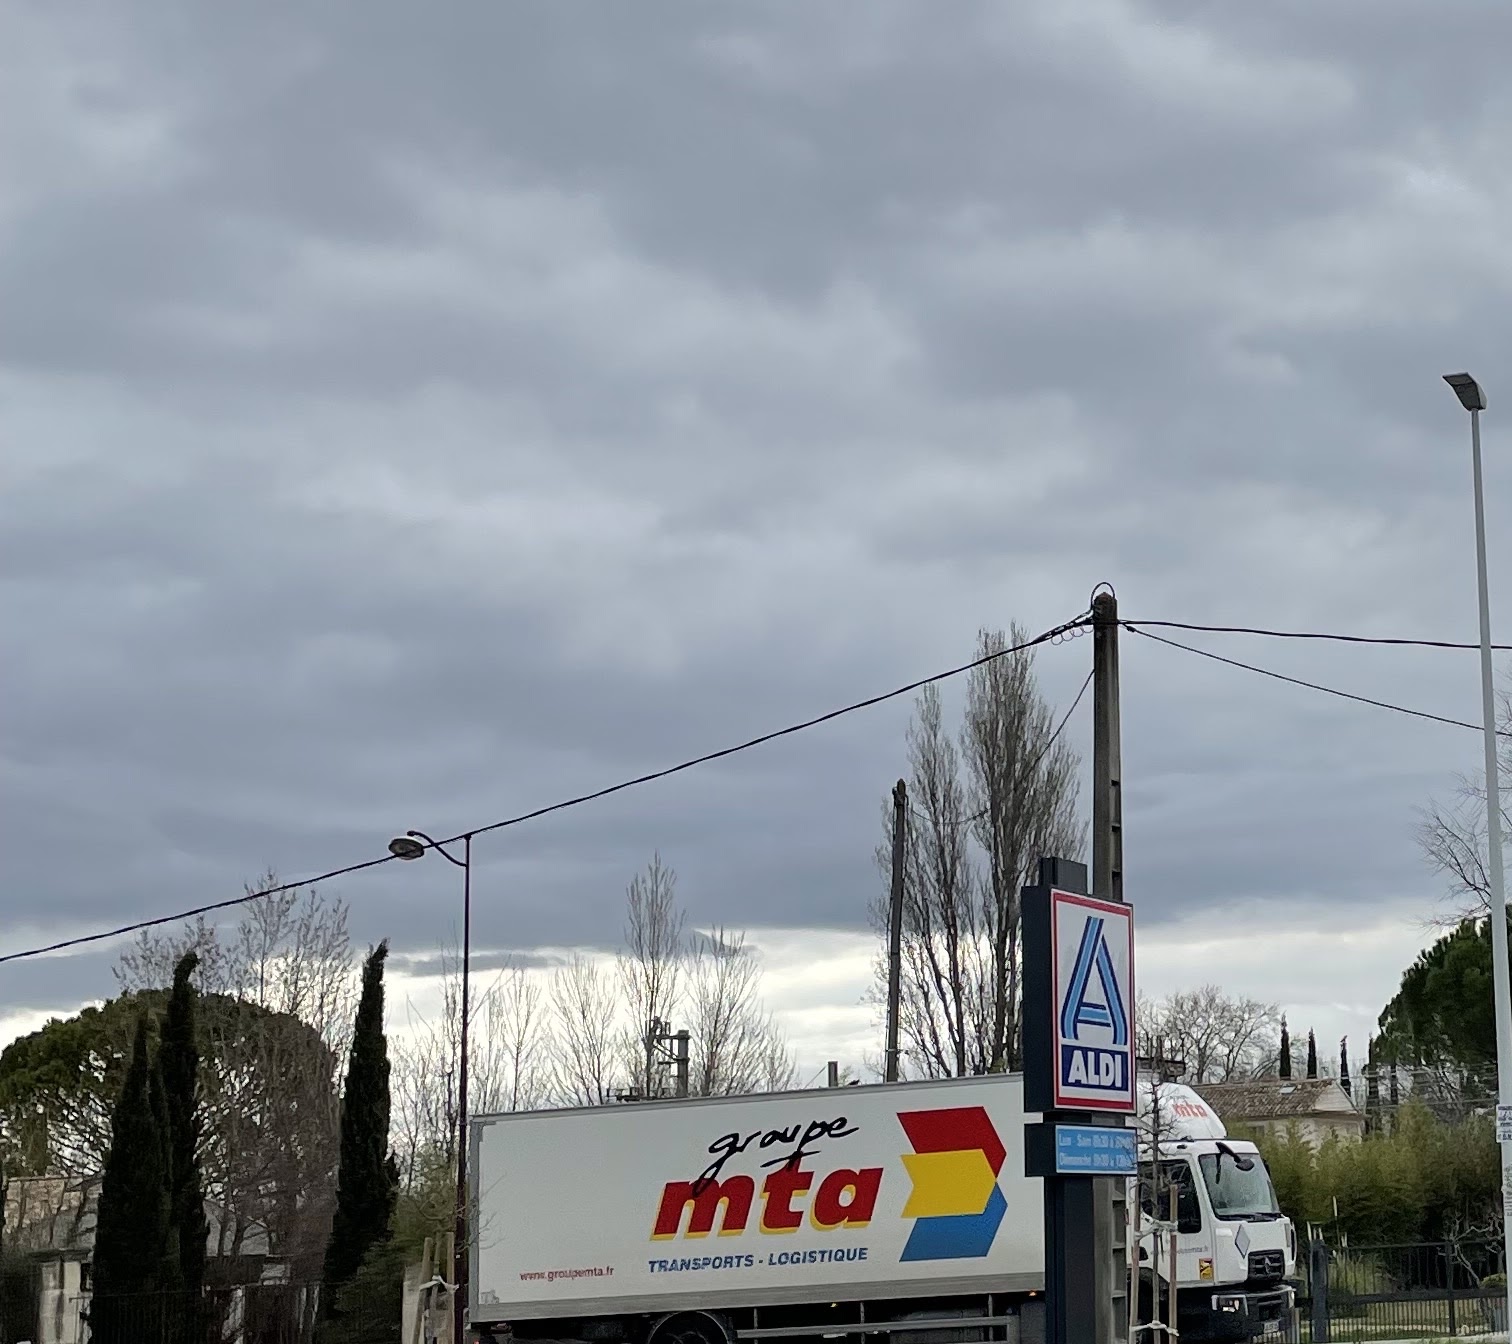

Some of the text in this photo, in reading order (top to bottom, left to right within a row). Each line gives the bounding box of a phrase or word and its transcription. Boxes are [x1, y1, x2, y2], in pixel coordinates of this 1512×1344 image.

[1067, 1050, 1123, 1088] ALDI
[692, 1116, 860, 1197] groupe
[649, 1151, 884, 1242] mta
[649, 1254, 754, 1273] TRANSPORTS
[768, 1247, 869, 1266] LOGISTIQUE
